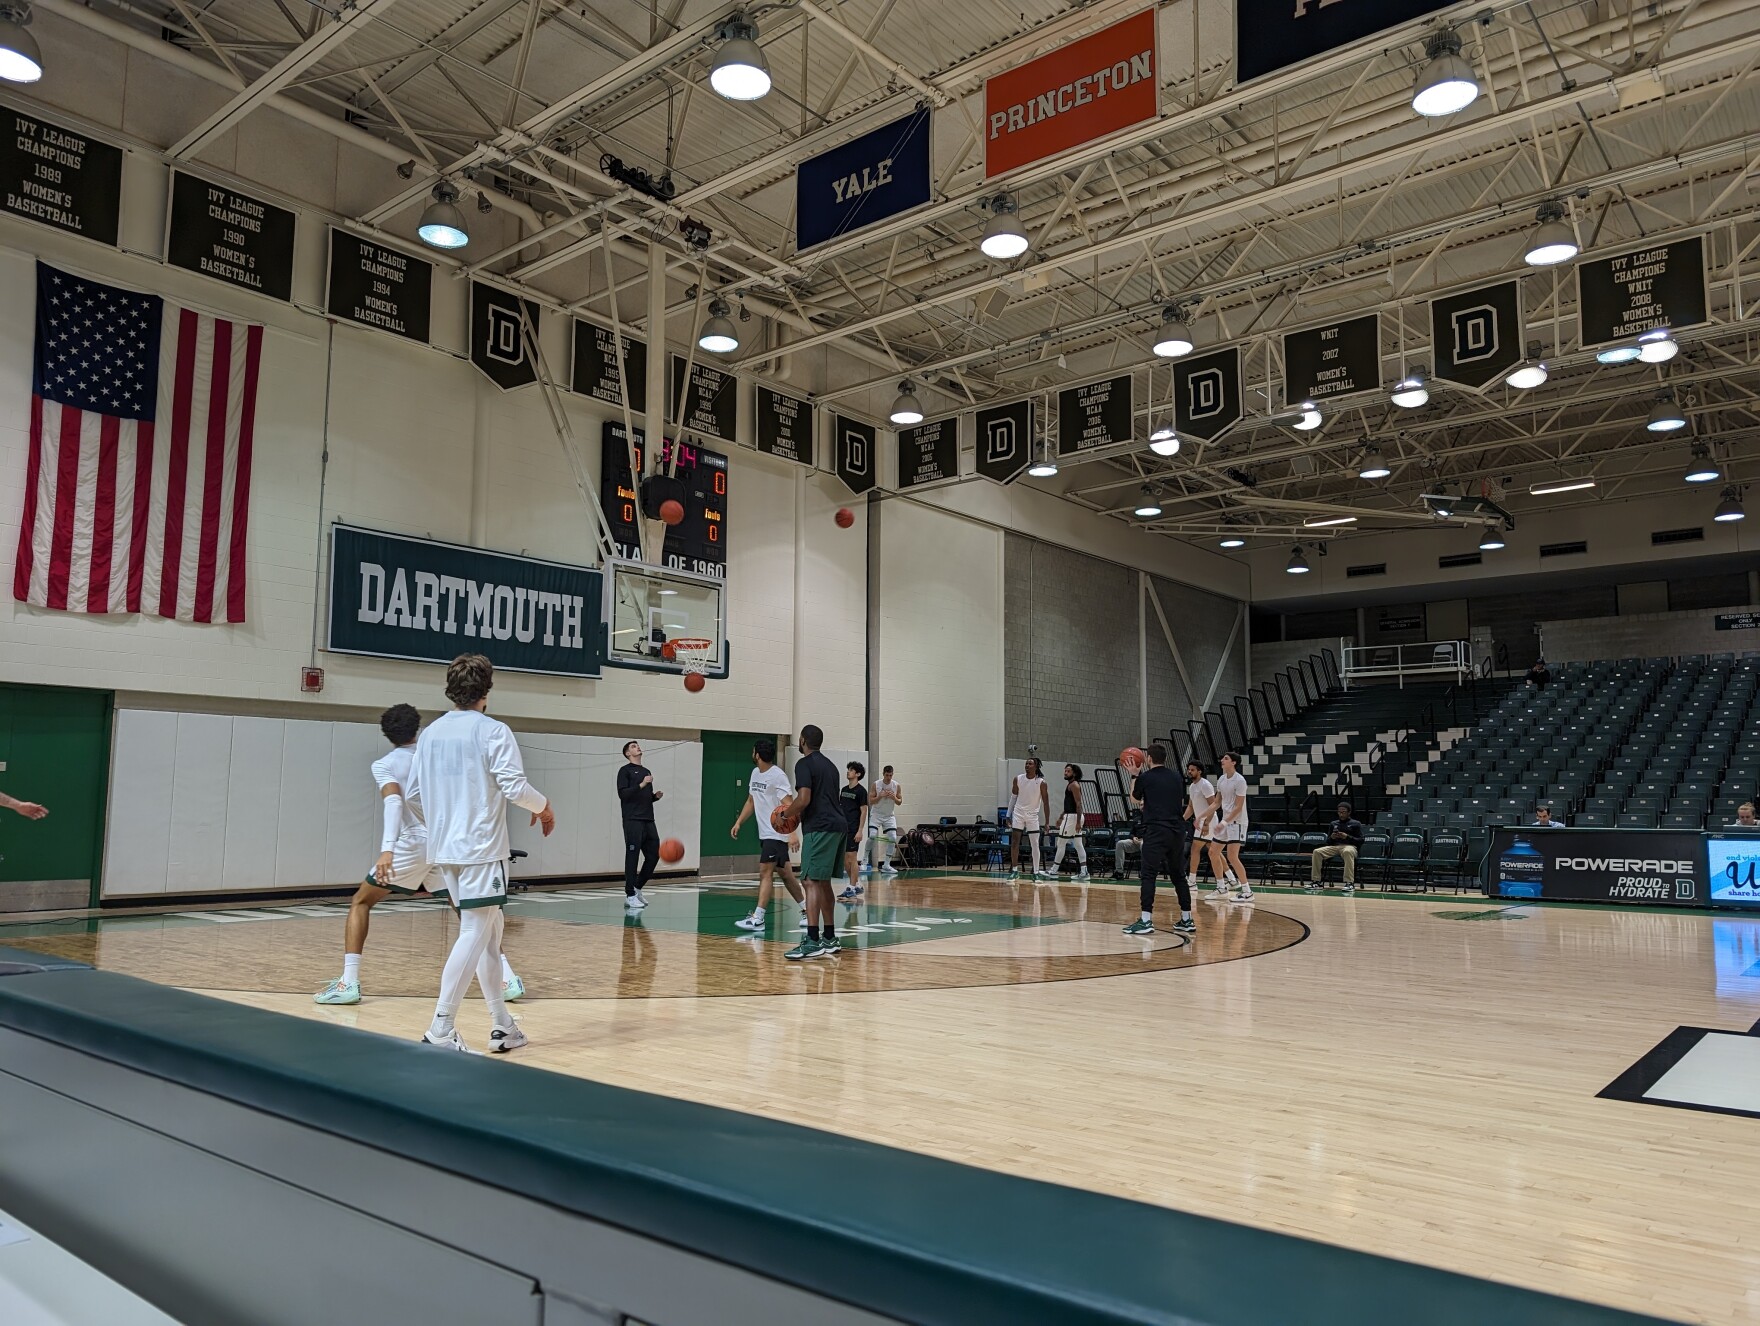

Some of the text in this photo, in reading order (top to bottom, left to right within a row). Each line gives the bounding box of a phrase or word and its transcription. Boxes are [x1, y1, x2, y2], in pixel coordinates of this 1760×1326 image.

[990, 50, 1153, 141] PRINCETON
[16, 118, 86, 154] IVY LEAGUE
[17, 136, 82, 170] CHAMPIONS
[34, 163, 62, 184] 1989
[832, 158, 893, 204] YALE
[22, 180, 72, 208] WOMEN'S
[208, 188, 264, 218] IVY LEAGUE
[6, 193, 82, 230] BASKETBALL
[209, 204, 261, 232] CHAMPIONS
[223, 228, 245, 246] 1990
[213, 244, 255, 268] WOMEN'S
[360, 244, 406, 270] IVY LEAGUE
[1612, 248, 1668, 271] IVY LEAGUE
[200, 256, 262, 288] BASKETBALL
[361, 259, 404, 283] CHAMPIONS
[1614, 262, 1666, 283] CHAMPIONS
[373, 280, 390, 296] 1994
[1628, 279, 1653, 294] WNIT
[365, 295, 397, 315] WOMEN'S
[1631, 293, 1652, 307] 2008
[354, 306, 406, 332] BASKETBALL
[1622, 304, 1662, 321] WOMEN'S
[487, 303, 524, 366] D
[1321, 328, 1339, 340] WNIT
[1451, 303, 1498, 365] D
[1613, 316, 1671, 337] BASKETBALL
[692, 374, 719, 391] CHAMPIONS
[702, 367, 720, 382] LEAGUE
[1317, 366, 1347, 382] WOMEN'S
[1077, 382, 1112, 398] IVY LEAGUE
[1188, 367, 1224, 420] D
[1309, 379, 1355, 396] BASKETBALL
[1080, 392, 1109, 407] CHAMPIONS
[1086, 404, 1102, 415] NCAA
[773, 404, 798, 418] CHAMPIONS
[689, 419, 720, 436] BASKETBALL
[915, 432, 940, 445] CHAMPIONS
[987, 417, 1016, 463] D
[1077, 434, 1112, 449] BASKETBALL
[772, 445, 798, 460] BASKETBALL
[846, 430, 867, 475] D
[715, 472, 725, 494] 0
[913, 470, 944, 484] BASKETBALL
[624, 504, 632, 521] 0
[709, 525, 717, 541] 0
[669, 554, 686, 570] OF
[692, 560, 723, 578] 1960
[358, 562, 584, 649] DARTMOUTH
[1556, 858, 1694, 874] POWERADE
[1609, 886, 1670, 899] HYDRATE
[1618, 877, 1662, 888] PROUD
[1676, 879, 1695, 900] D
